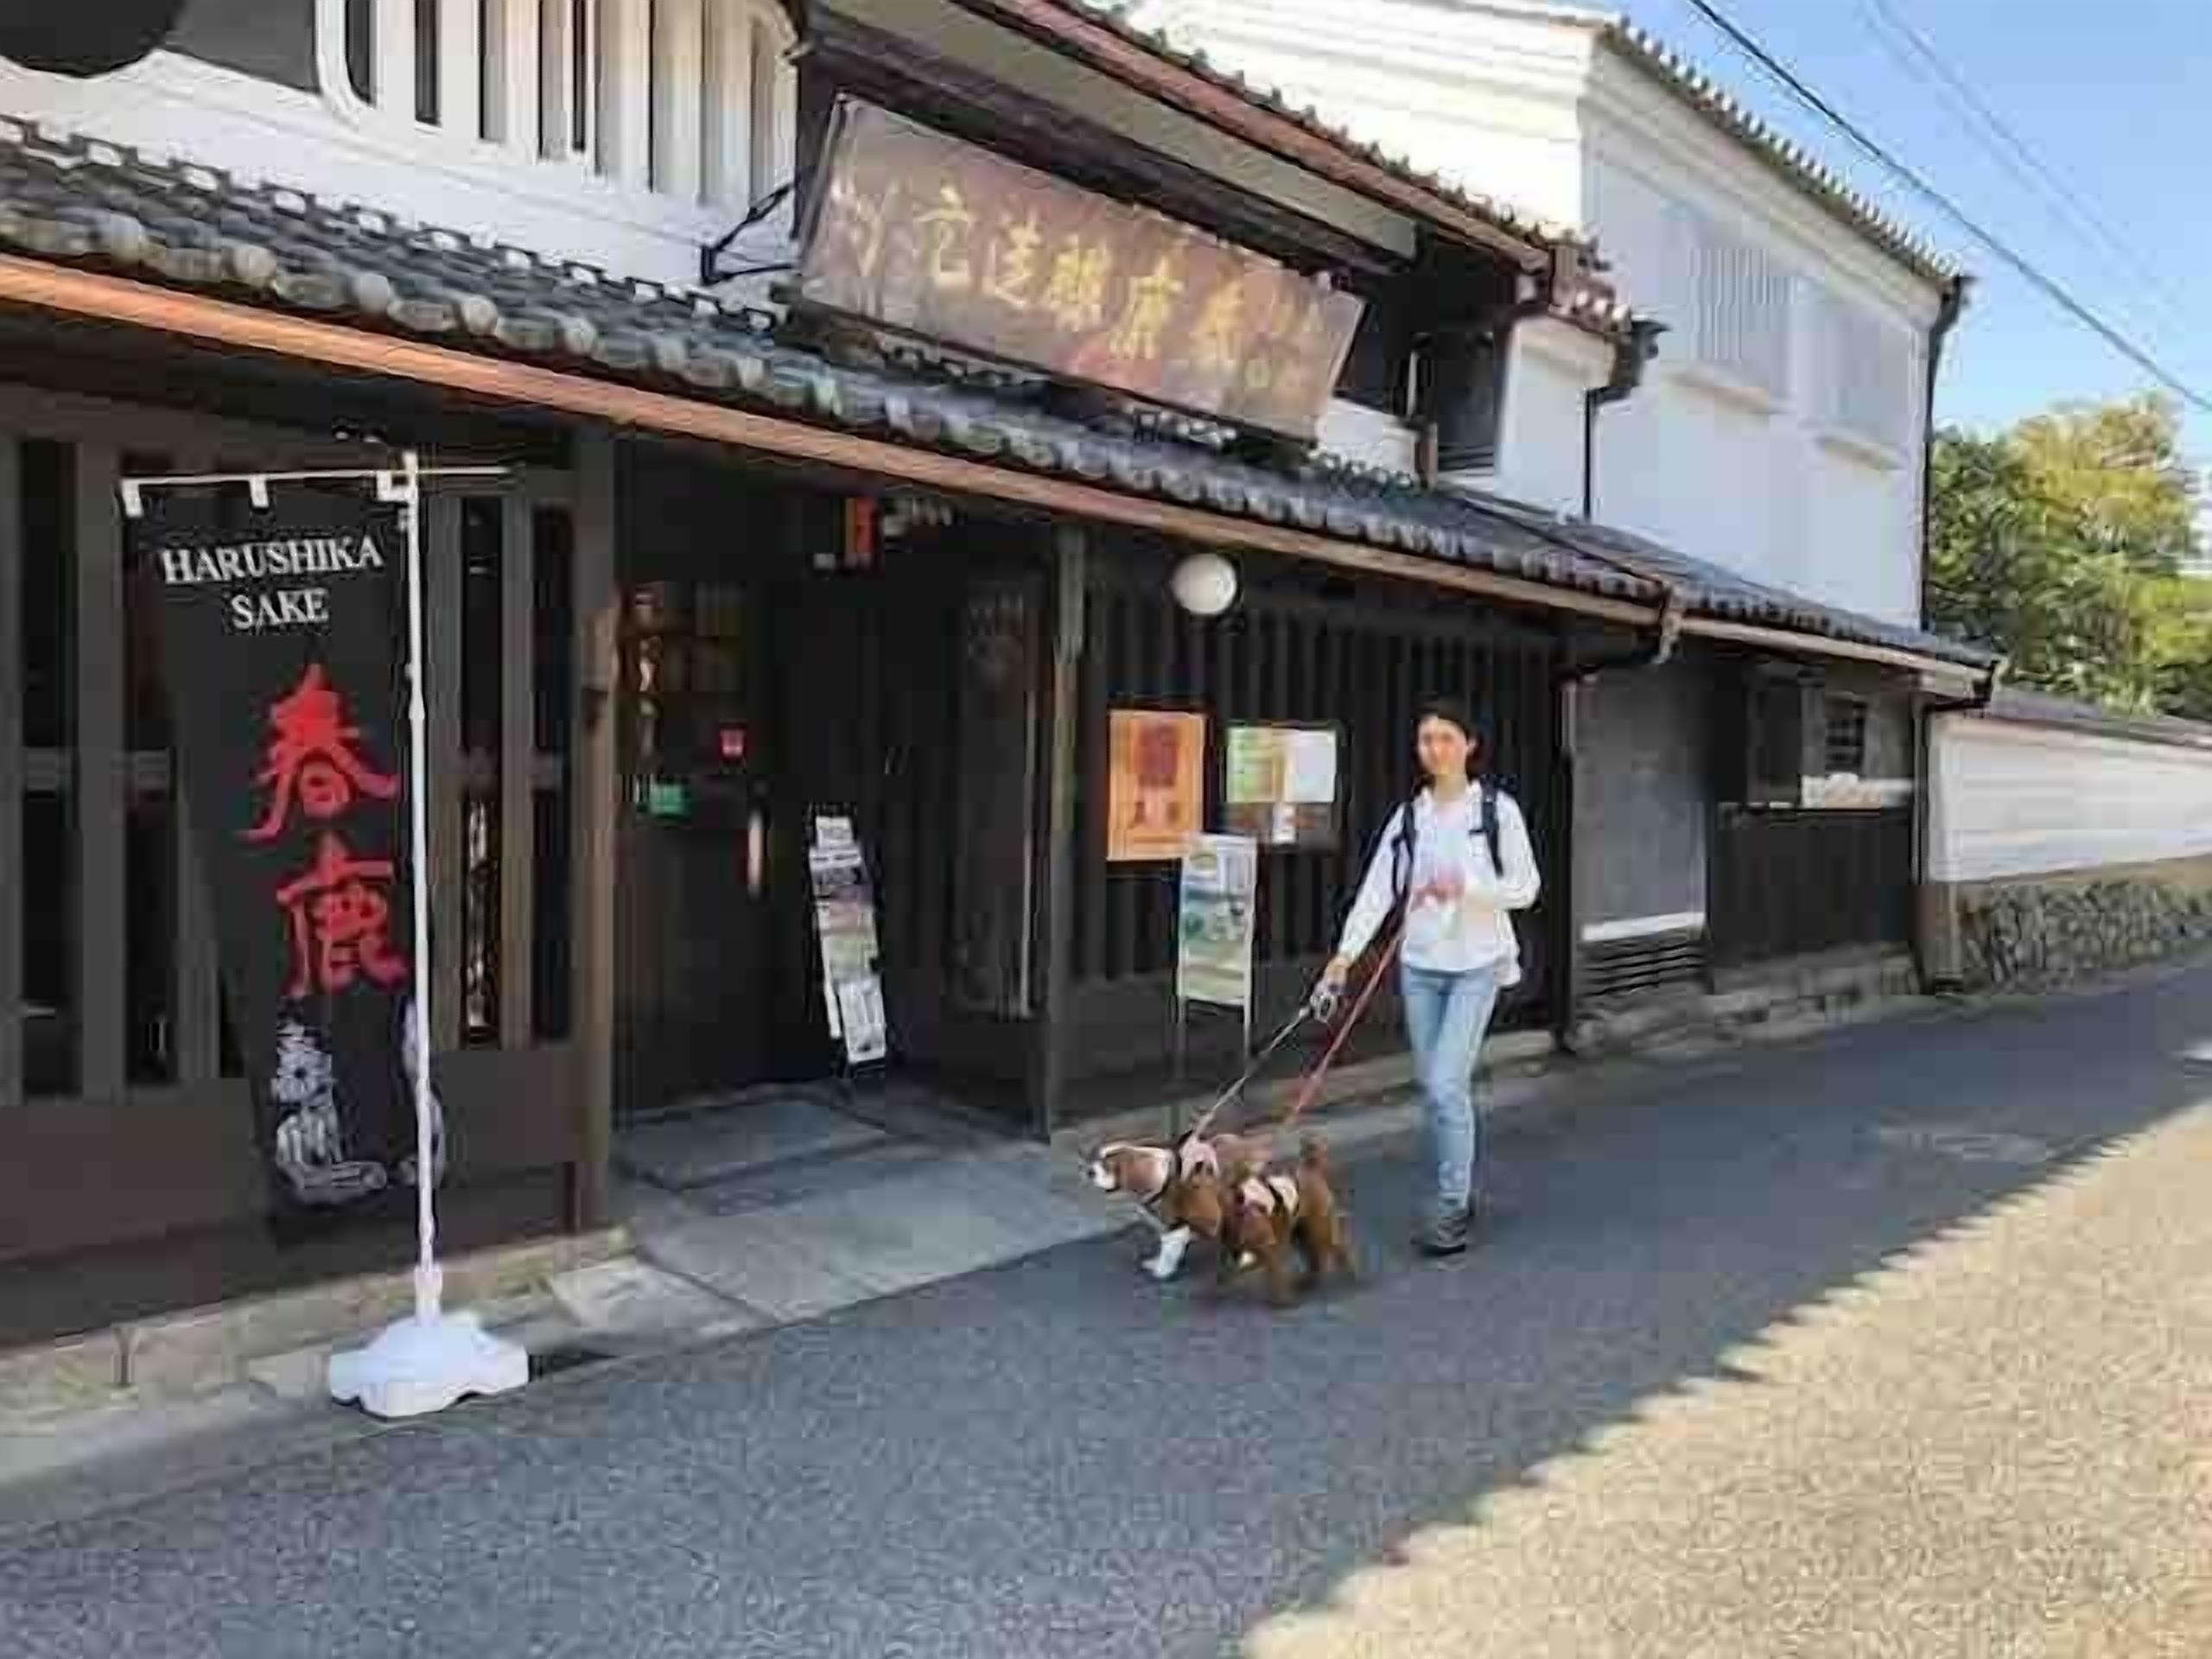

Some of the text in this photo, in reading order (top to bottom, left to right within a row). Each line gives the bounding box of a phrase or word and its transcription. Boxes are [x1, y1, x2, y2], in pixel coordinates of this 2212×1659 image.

[162, 535, 384, 584] HARUSHIKA
[231, 588, 329, 630] SAKE
[245, 663, 408, 995] 春鹿
